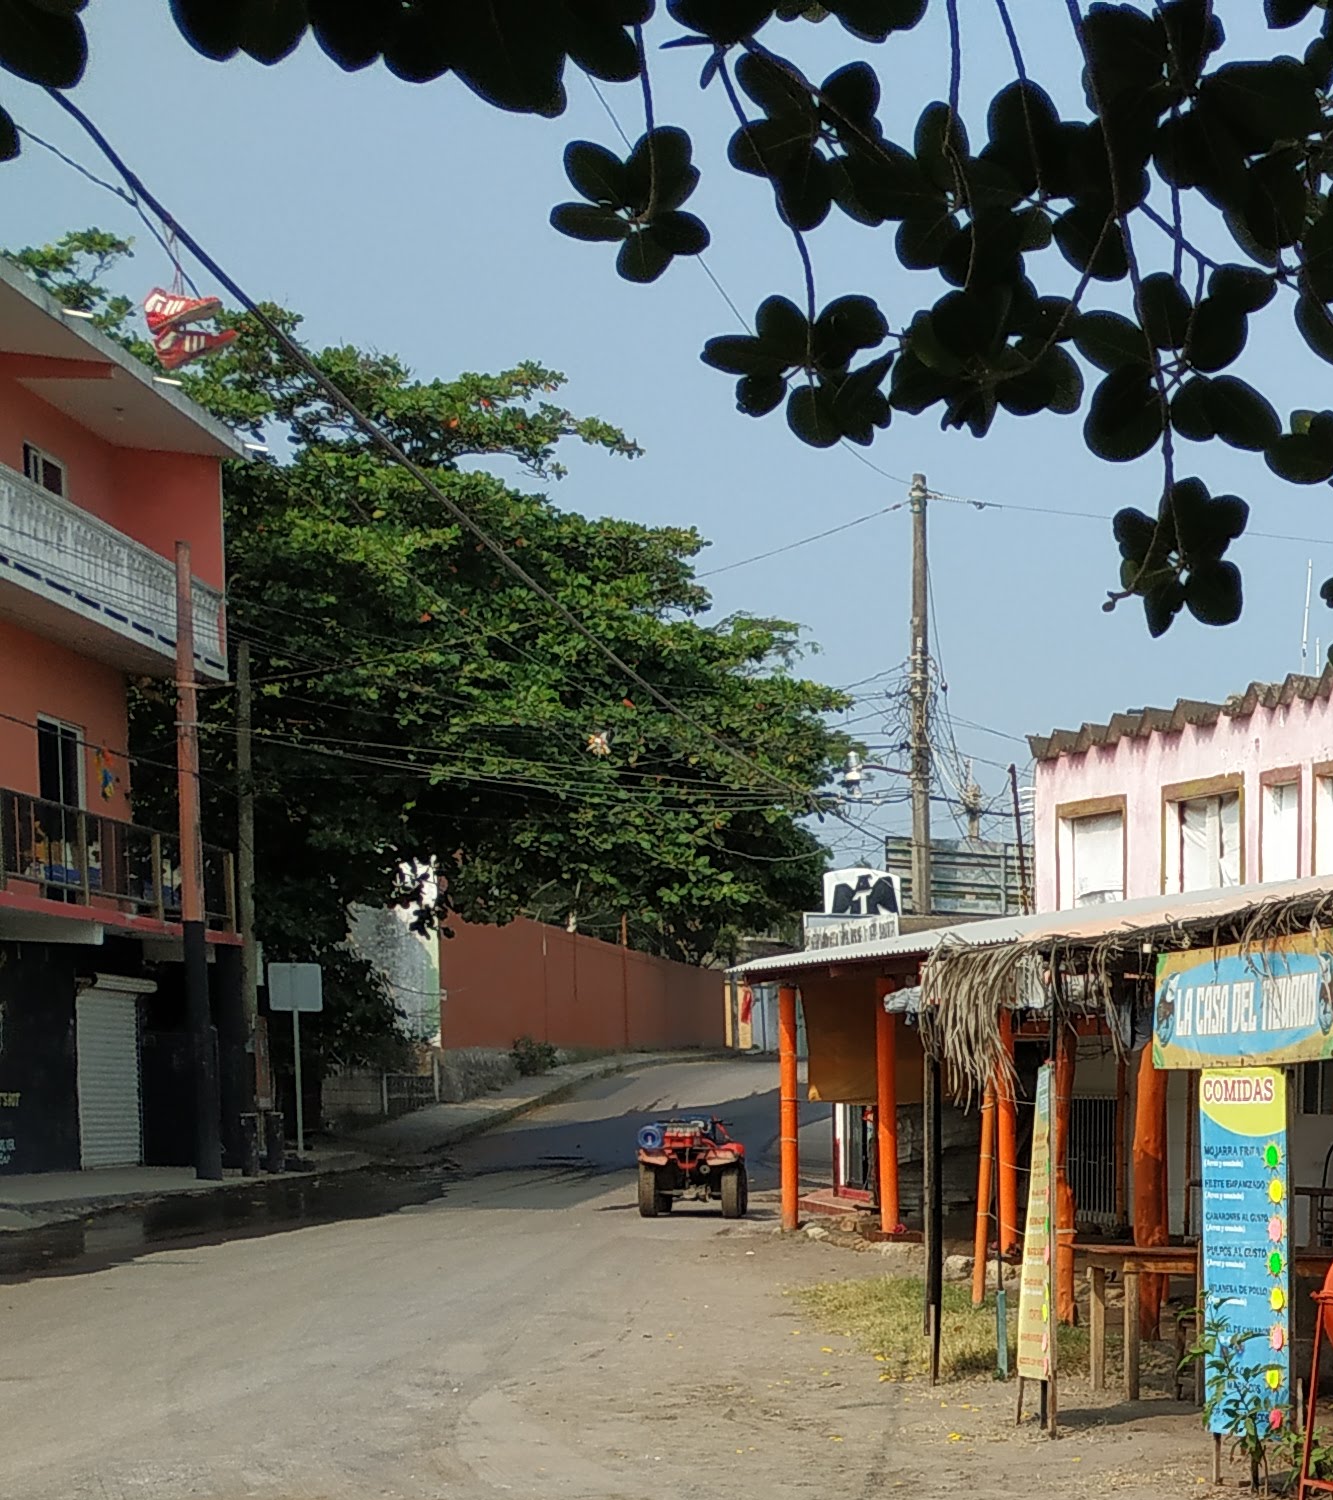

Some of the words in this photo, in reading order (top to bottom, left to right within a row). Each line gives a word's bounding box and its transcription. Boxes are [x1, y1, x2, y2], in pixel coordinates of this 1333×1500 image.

[1176, 988, 1194, 1036] LA
[1195, 984, 1229, 1035] CASA
[1231, 981, 1257, 1033] DEL
[1203, 1078, 1274, 1103] COMIDAS
